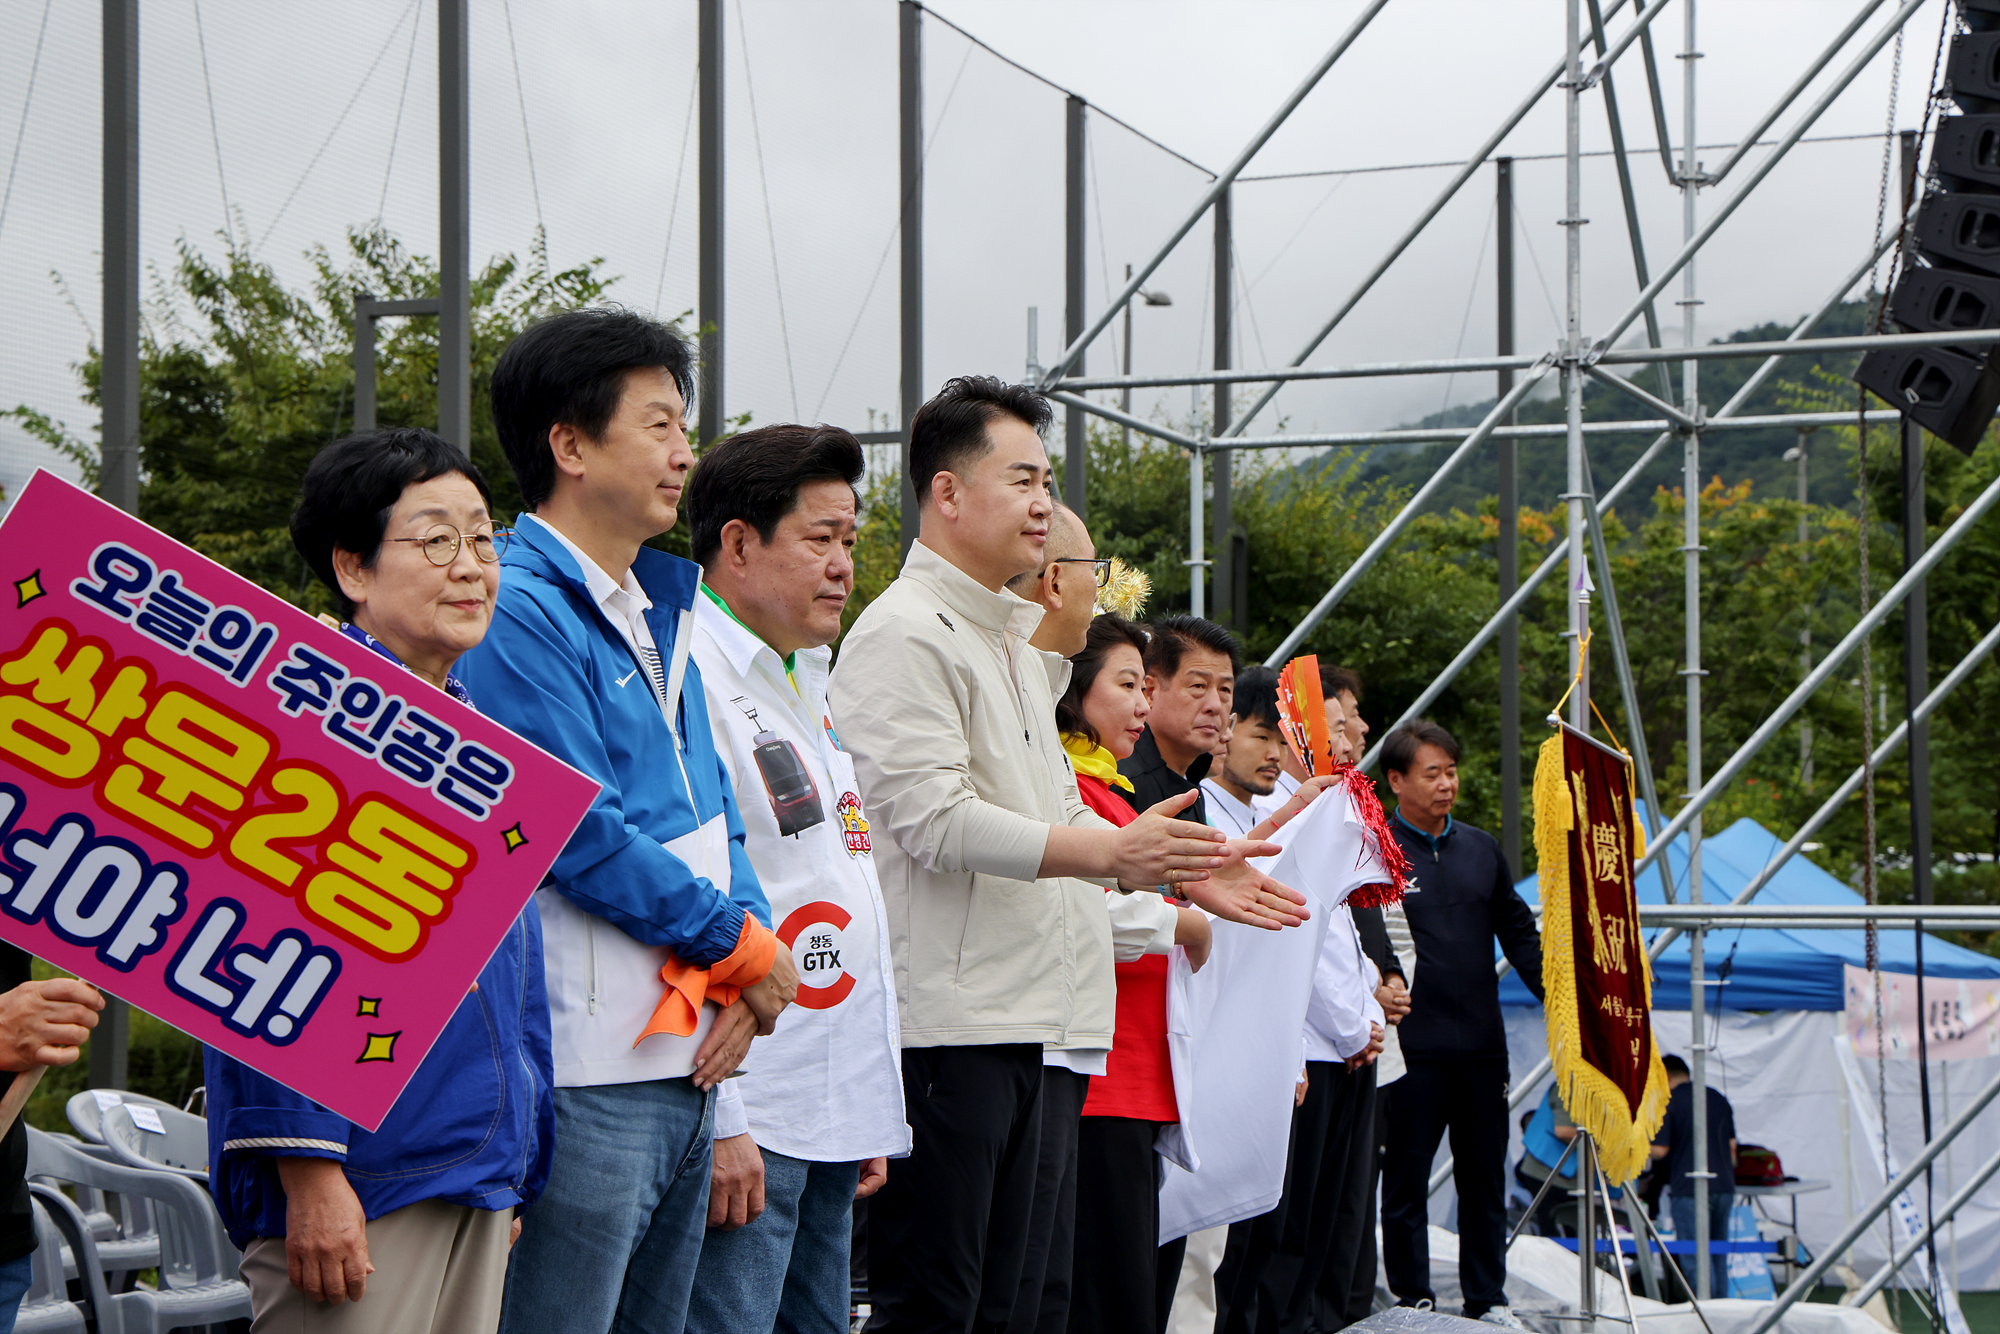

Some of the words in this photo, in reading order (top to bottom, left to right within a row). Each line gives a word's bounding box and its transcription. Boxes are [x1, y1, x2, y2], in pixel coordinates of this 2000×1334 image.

[72, 543, 276, 685] 오늘의
[270, 644, 513, 820] 주인공은
[0, 620, 474, 959] 쌍문2동
[170, 902, 337, 1043] 너!
[802, 950, 842, 972] GTX
[809, 934, 833, 950] 창동
